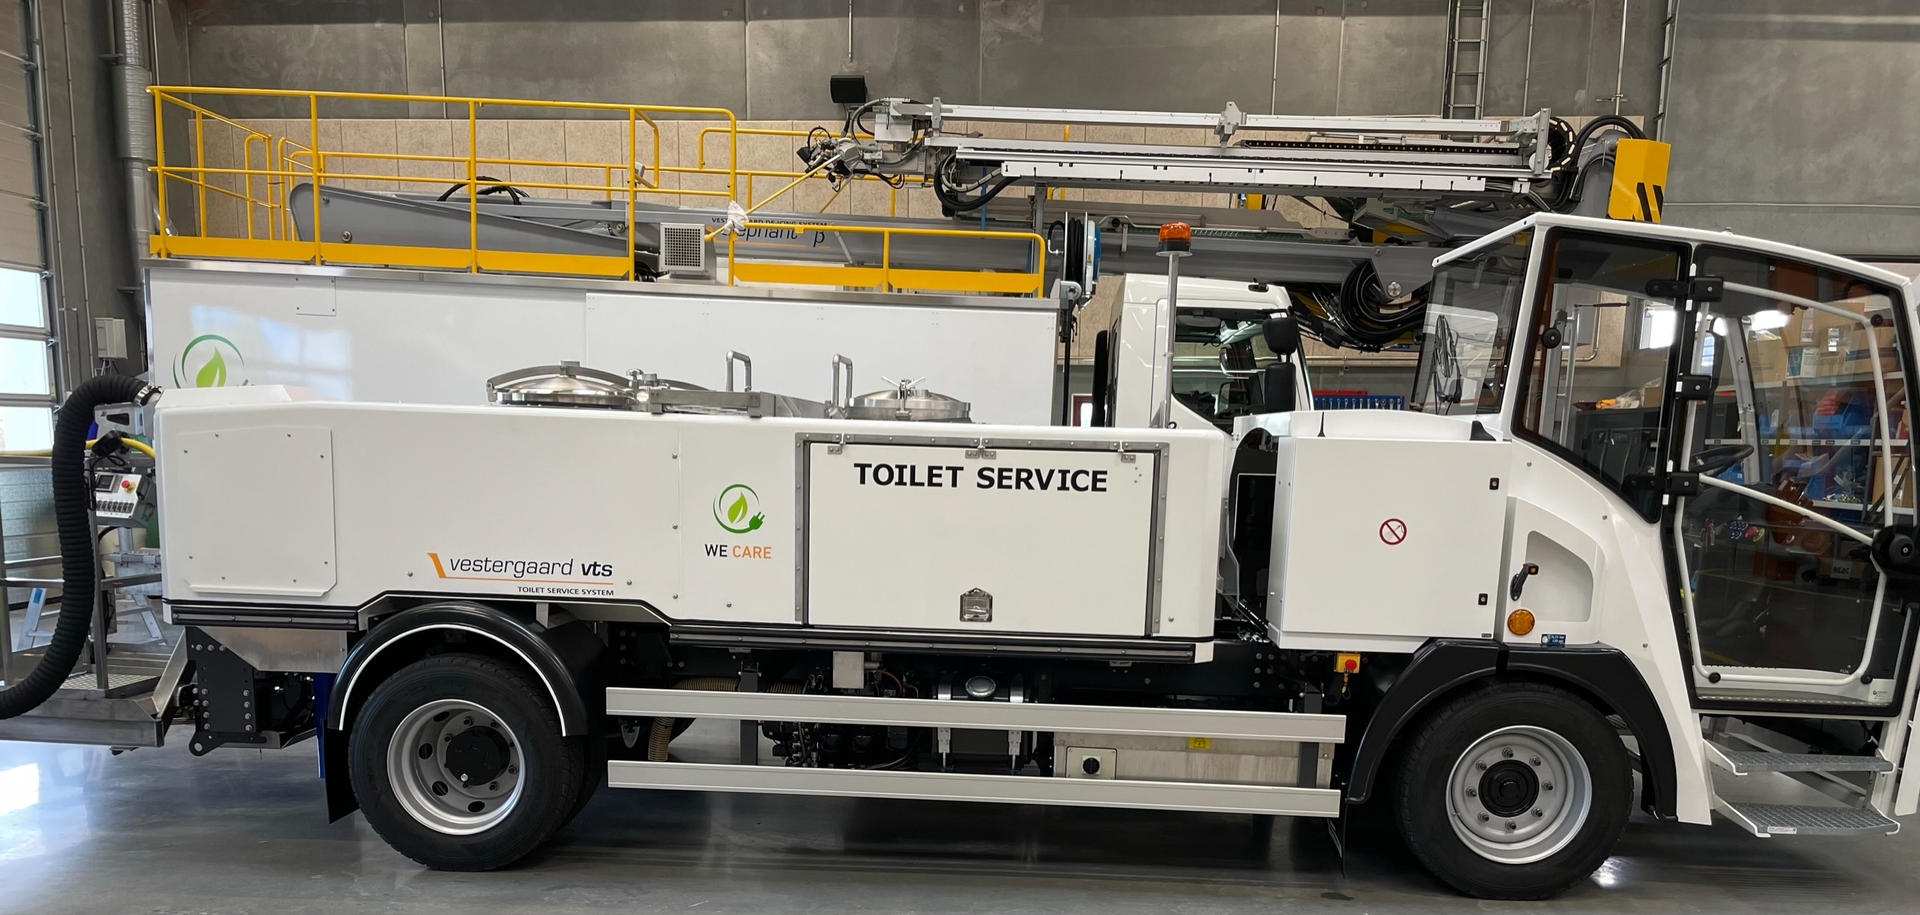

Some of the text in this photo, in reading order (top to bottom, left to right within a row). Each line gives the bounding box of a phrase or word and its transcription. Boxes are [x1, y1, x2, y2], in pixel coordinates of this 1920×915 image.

[853, 463, 1109, 492] TOILET SERVICE
[704, 543, 773, 559] WE CARE
[449, 556, 614, 579] vestergaard vts
[517, 586, 615, 596] TOILET SERVICE SYSTEM
